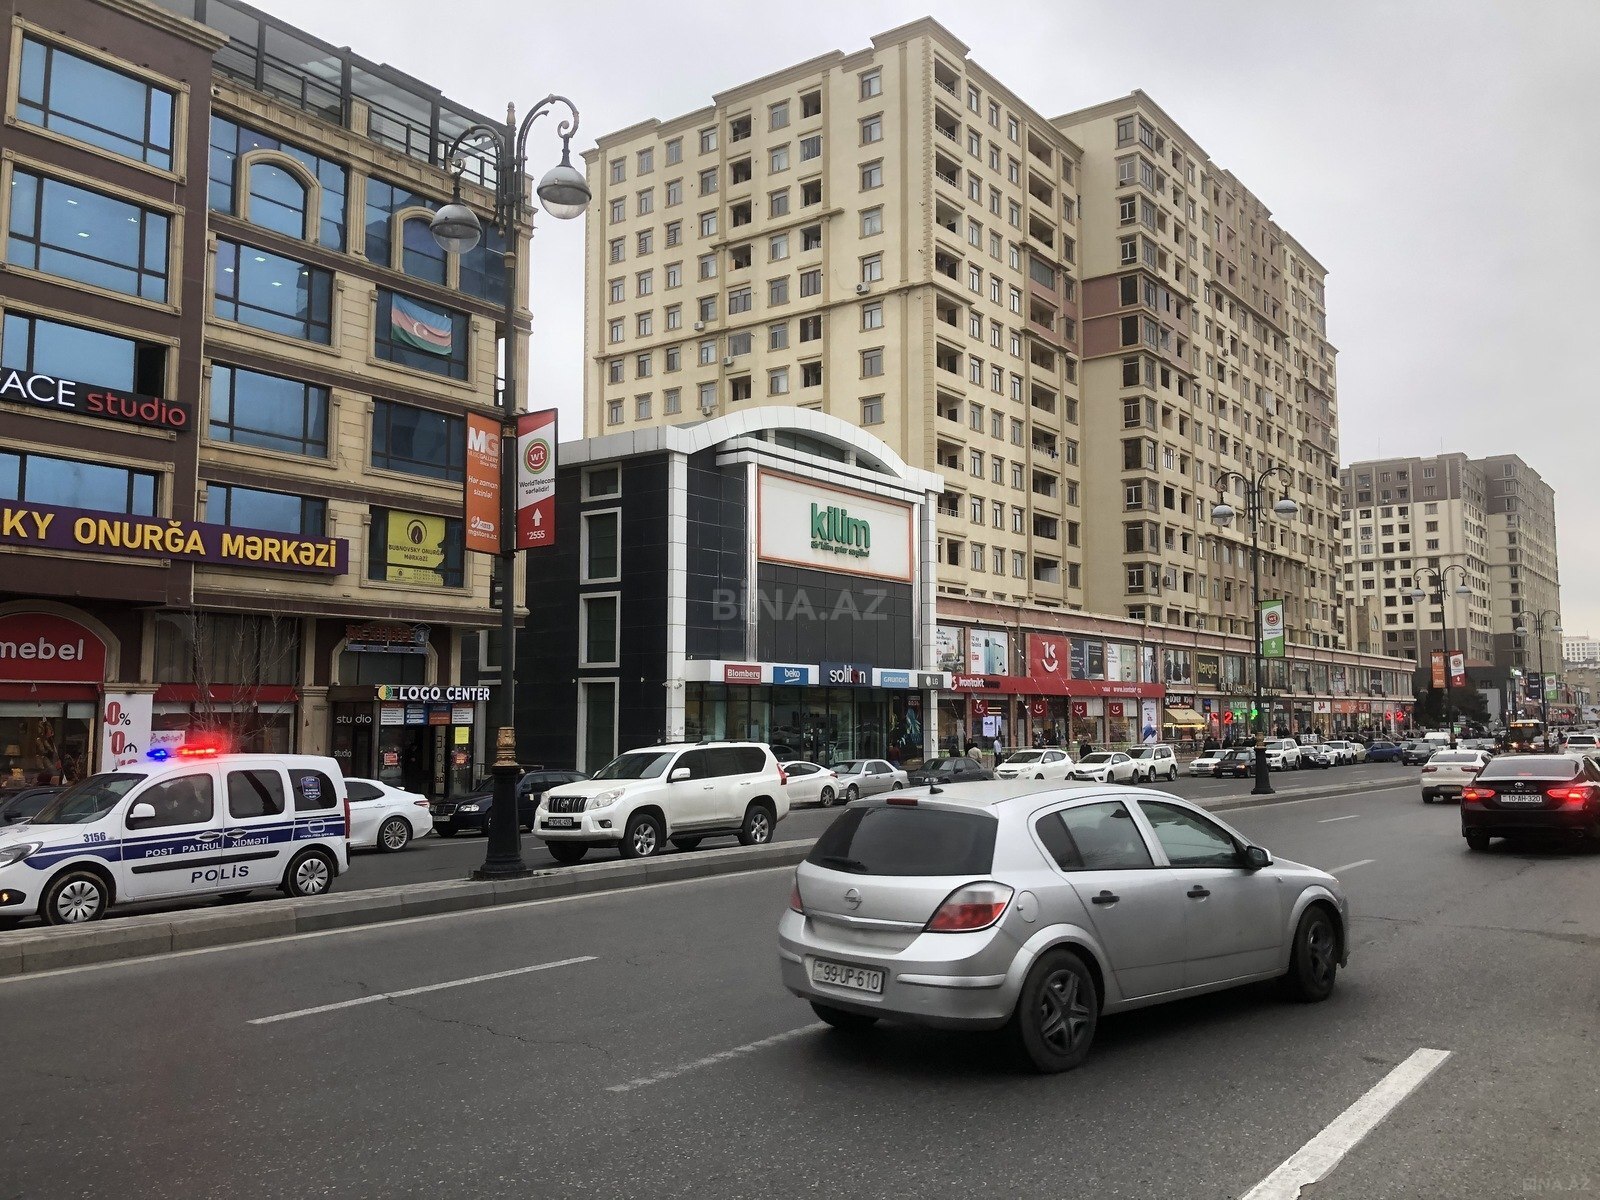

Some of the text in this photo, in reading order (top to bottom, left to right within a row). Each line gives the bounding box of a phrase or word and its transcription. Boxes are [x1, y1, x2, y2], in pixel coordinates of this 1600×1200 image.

[0, 367, 187, 426] ACE studio
[468, 427, 499, 457] MG
[531, 452, 544, 461] wt
[519, 477, 555, 488] WorldTelecom
[811, 502, 870, 549] kilim
[2, 508, 337, 567] KY ONURĞA MƏRKƏZİ
[0, 636, 84, 661] mebel
[727, 668, 760, 679] Blomberg
[784, 668, 801, 678] beko
[883, 676, 908, 684] GRUNDIG
[932, 677, 939, 686] LG
[399, 686, 490, 701] LOGO CENTER
[83, 832, 107, 843] 3156
[145, 835, 269, 858] POST PATRUL XİDMƏTİ
[191, 865, 249, 884] POLİS
[824, 965, 880, 990] 99-UP-610
